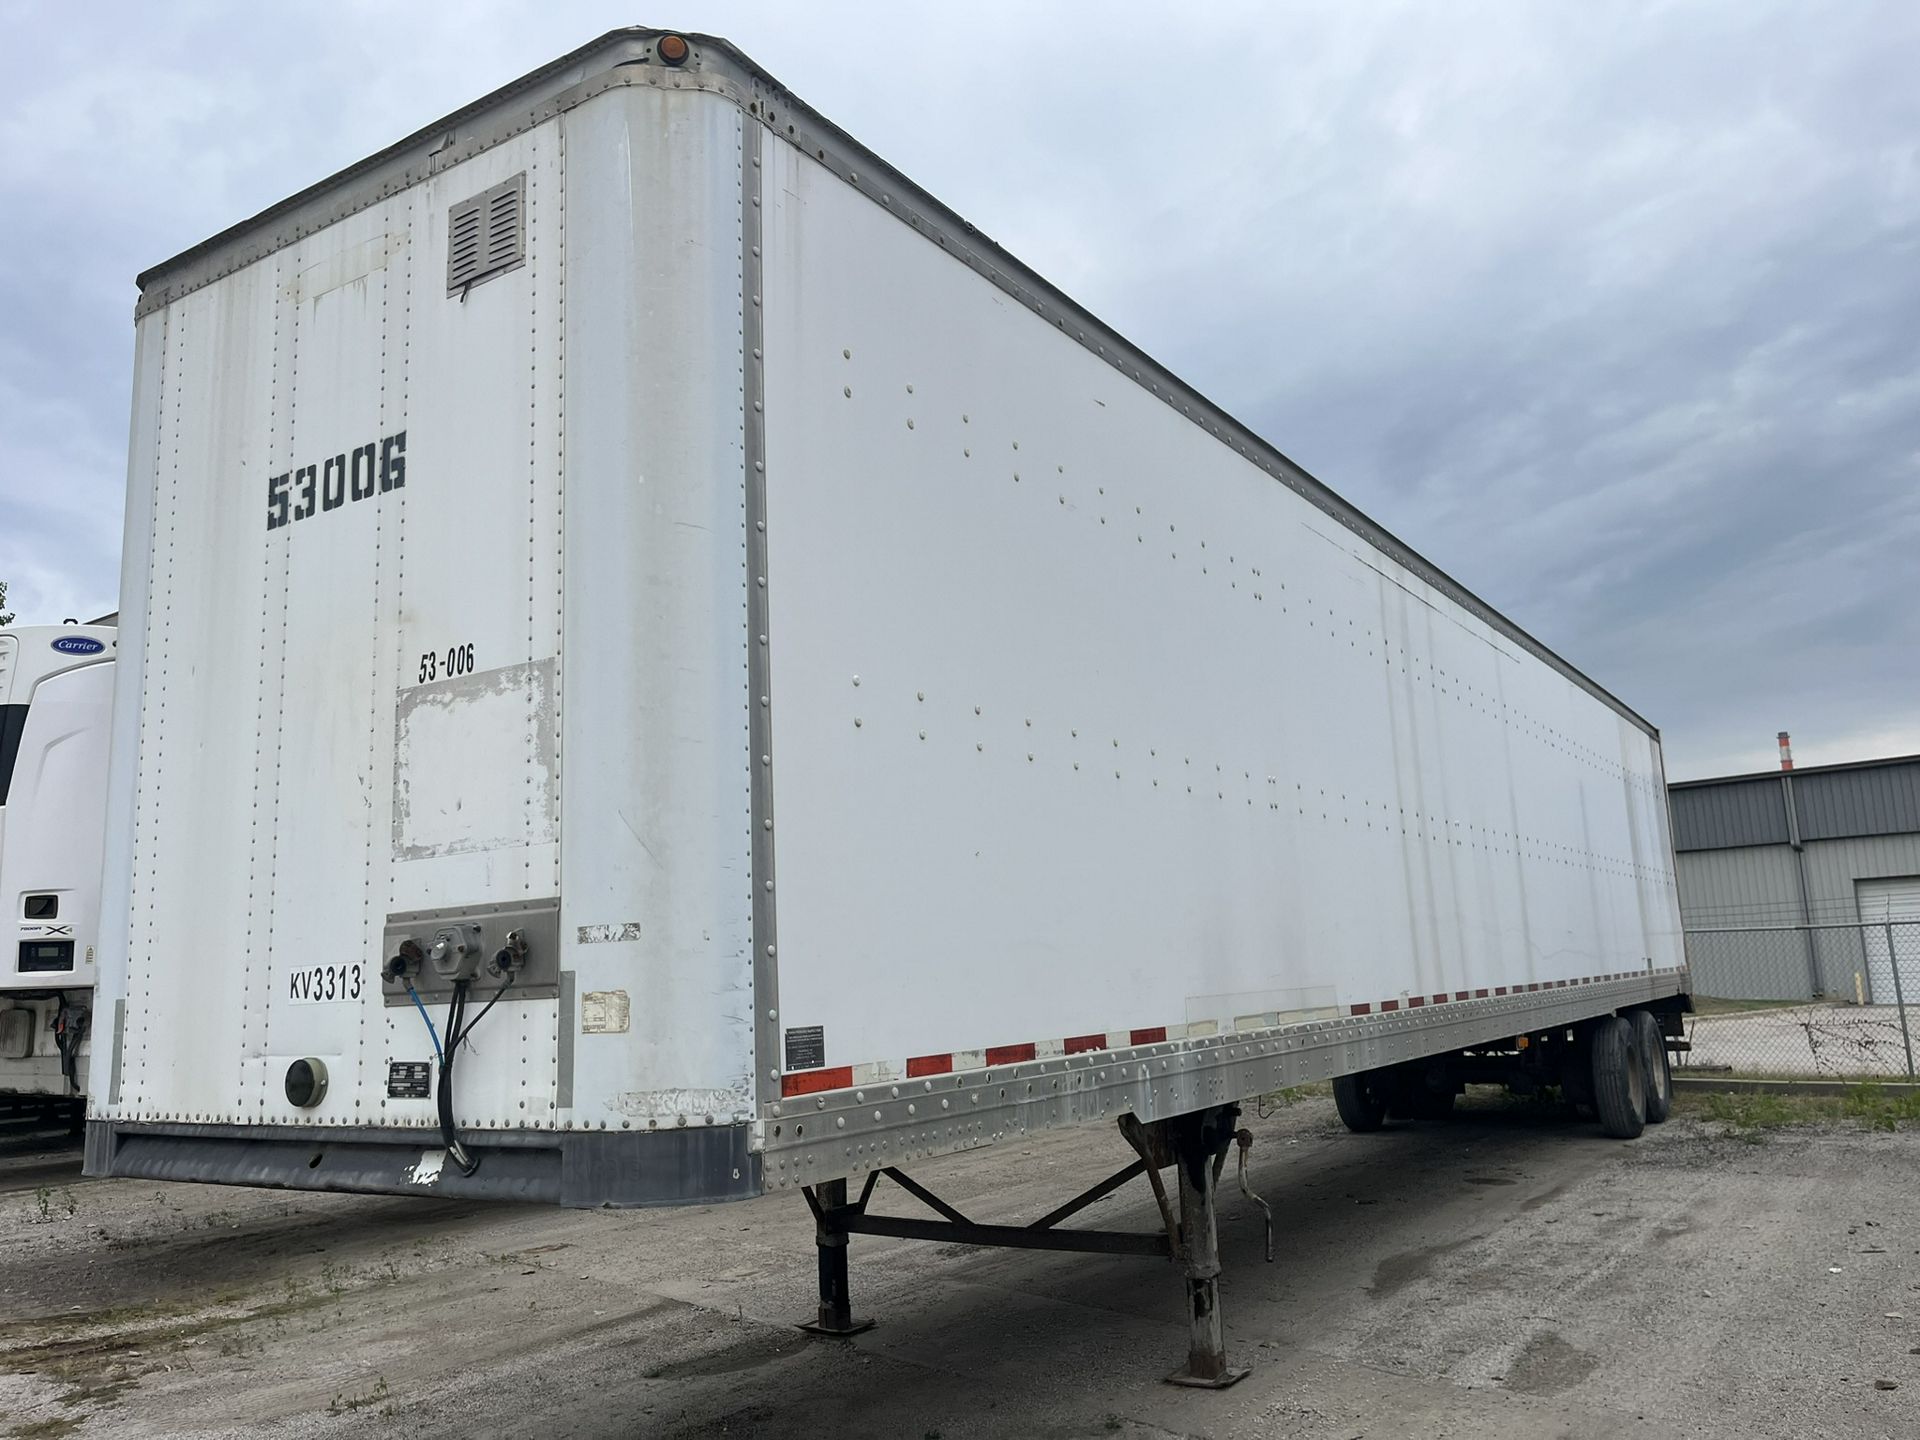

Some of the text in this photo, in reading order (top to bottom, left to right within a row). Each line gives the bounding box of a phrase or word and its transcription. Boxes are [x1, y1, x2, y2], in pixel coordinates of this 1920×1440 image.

[267, 430, 407, 531] 53006
[58, 639, 98, 651] Carrier
[419, 643, 474, 684] 53-006
[290, 964, 361, 1002] KV3313
